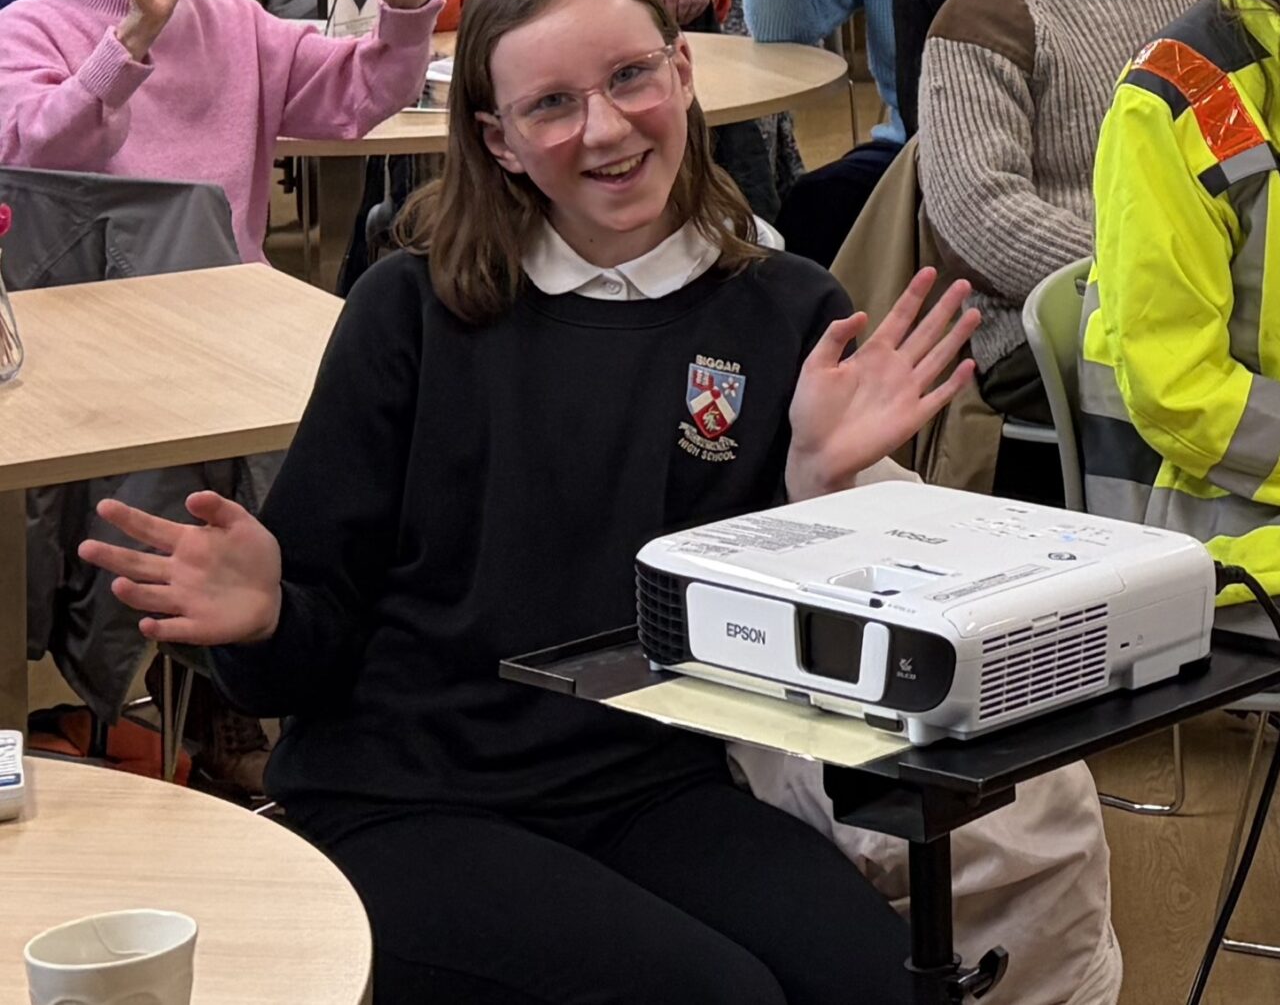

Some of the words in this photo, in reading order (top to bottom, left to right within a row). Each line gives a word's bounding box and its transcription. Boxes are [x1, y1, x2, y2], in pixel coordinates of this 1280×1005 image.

[695, 354, 741, 373] BIGGAR
[678, 437, 701, 457] HIGH
[701, 450, 737, 462] SCHOOL
[726, 622, 766, 645] EPSON
